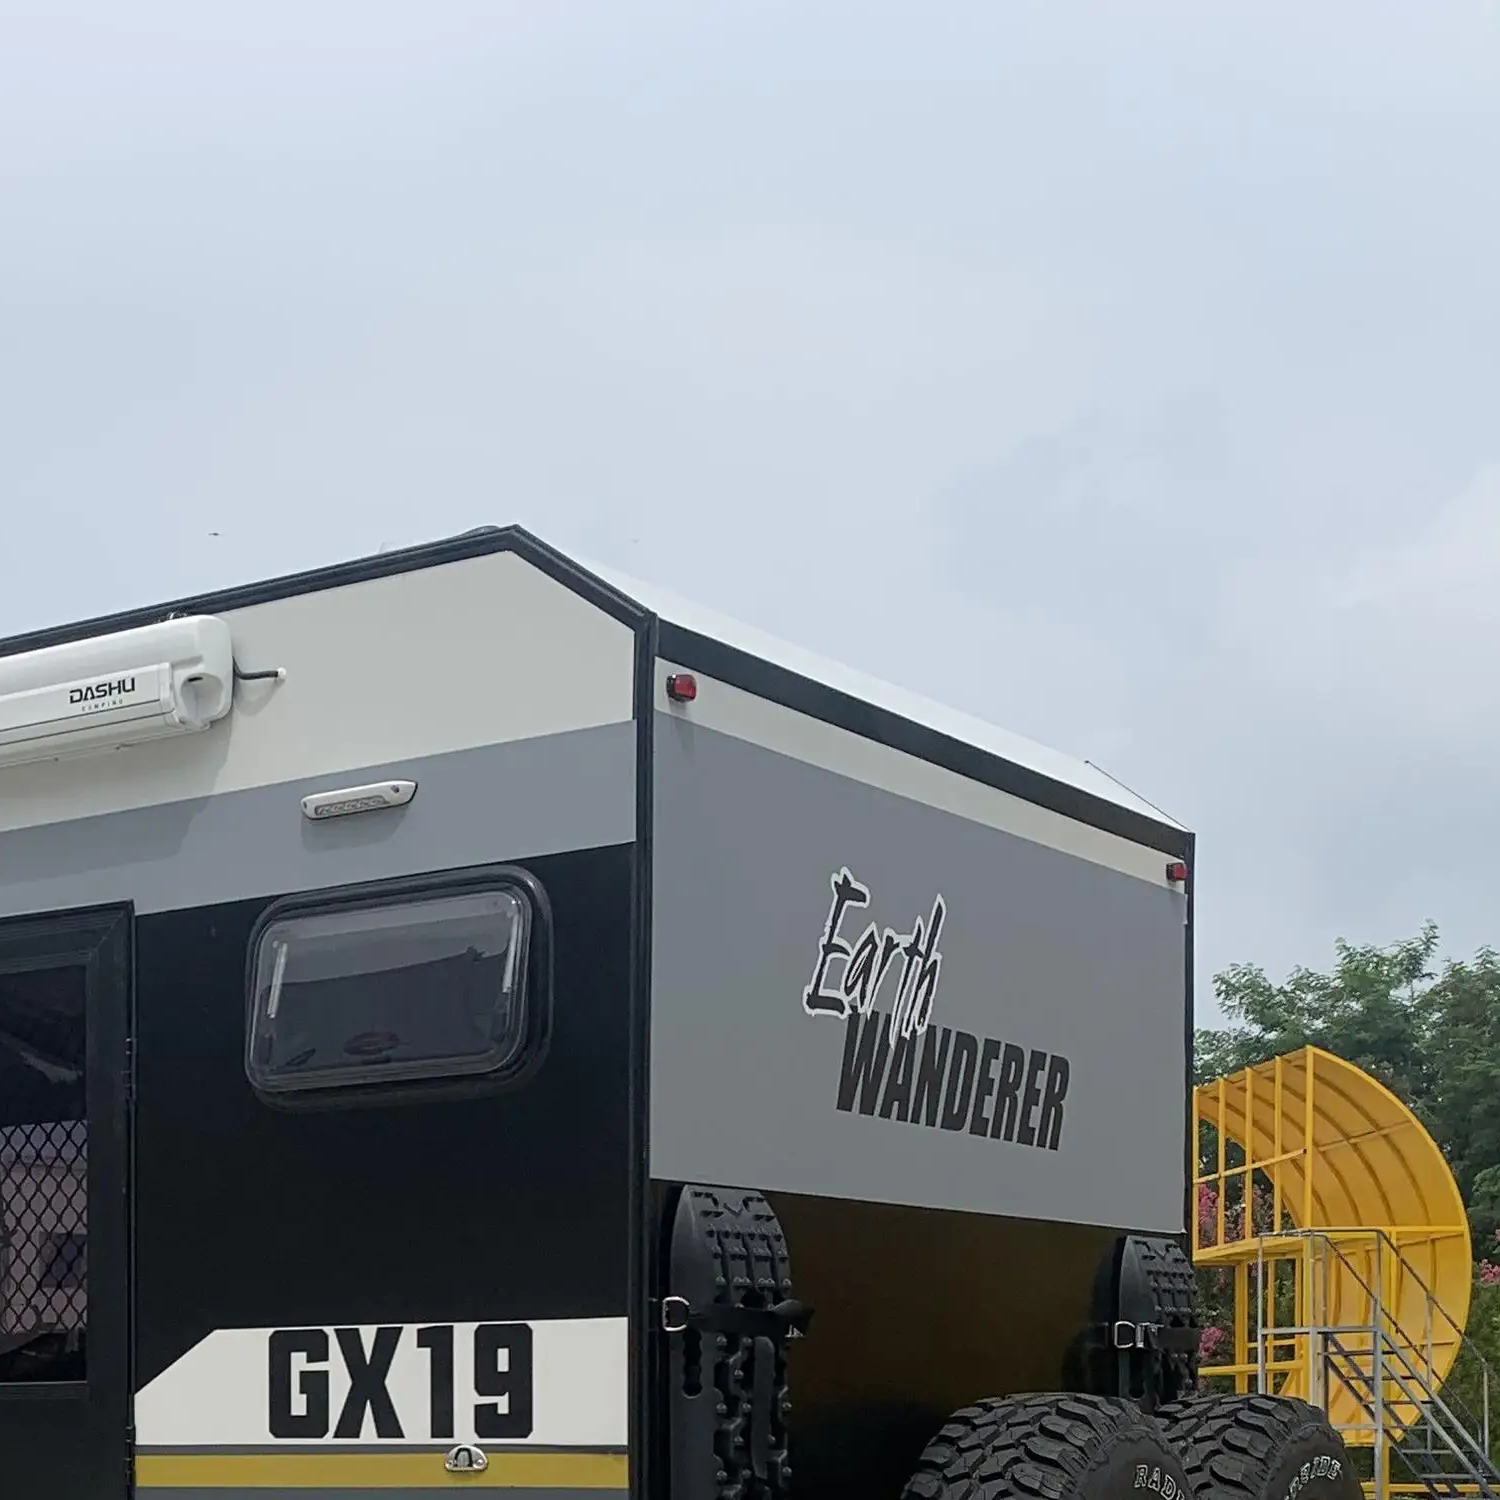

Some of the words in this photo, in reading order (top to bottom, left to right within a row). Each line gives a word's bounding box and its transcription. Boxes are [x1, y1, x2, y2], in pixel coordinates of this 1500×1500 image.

[69, 677, 135, 704] DASHU
[803, 866, 947, 1048] Earth
[836, 1005, 1071, 1151] WANDERER
[268, 1323, 533, 1439] GX19
